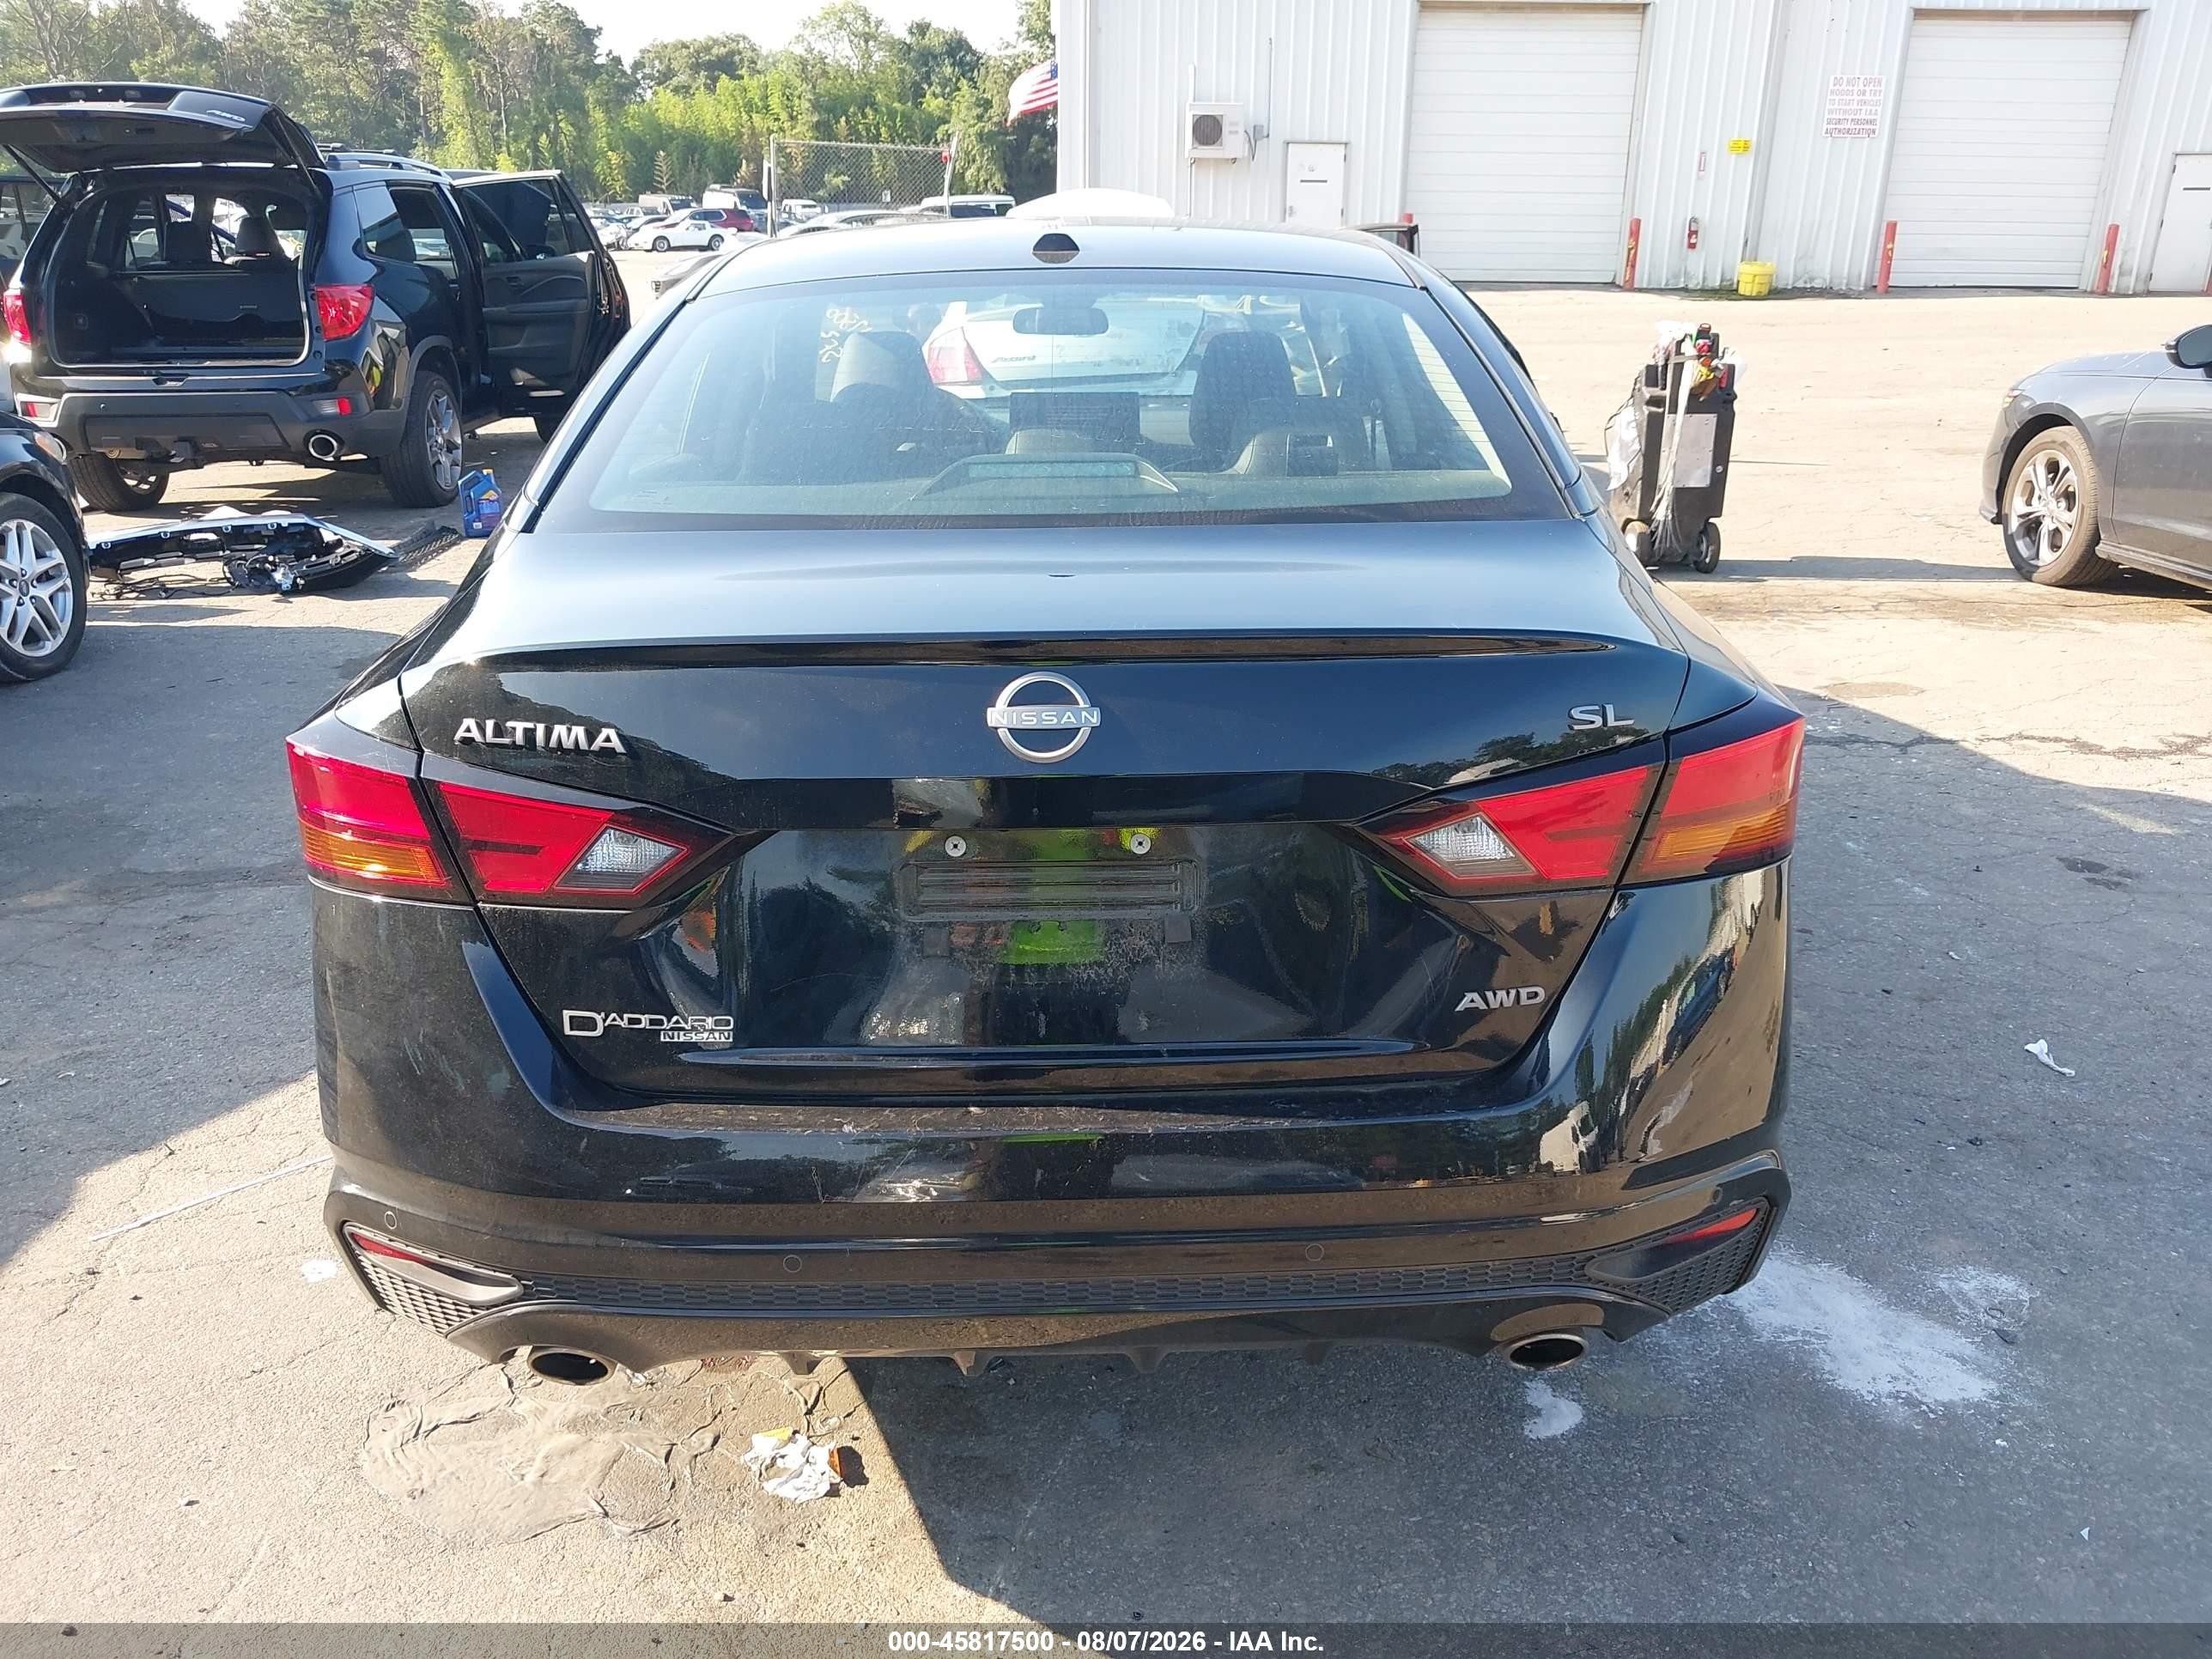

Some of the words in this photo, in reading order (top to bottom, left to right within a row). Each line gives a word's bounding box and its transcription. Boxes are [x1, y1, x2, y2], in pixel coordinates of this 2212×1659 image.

[1833, 76, 1844, 88] DO
[1845, 76, 1861, 88] NOT
[1863, 76, 1883, 88] OPEN
[1829, 88, 1855, 97] HOODS
[1856, 88, 1867, 97] OR
[1869, 88, 1882, 97] TRY
[1828, 98, 1836, 106] TO
[1837, 98, 1856, 106] START
[1856, 98, 1882, 107] VEHICLES
[1826, 118, 1850, 126] SECURITY
[1850, 118, 1877, 126] PERSONNEL
[1824, 127, 1876, 136] AUTHORIZATION
[990, 709, 1098, 726] NISSAN
[1569, 703, 1636, 731] SL
[453, 718, 627, 754] ALTIMA
[1454, 985, 1546, 1012] AWD
[562, 1009, 734, 1038] D'ADDARIO
[661, 1030, 733, 1042] NISSAN
